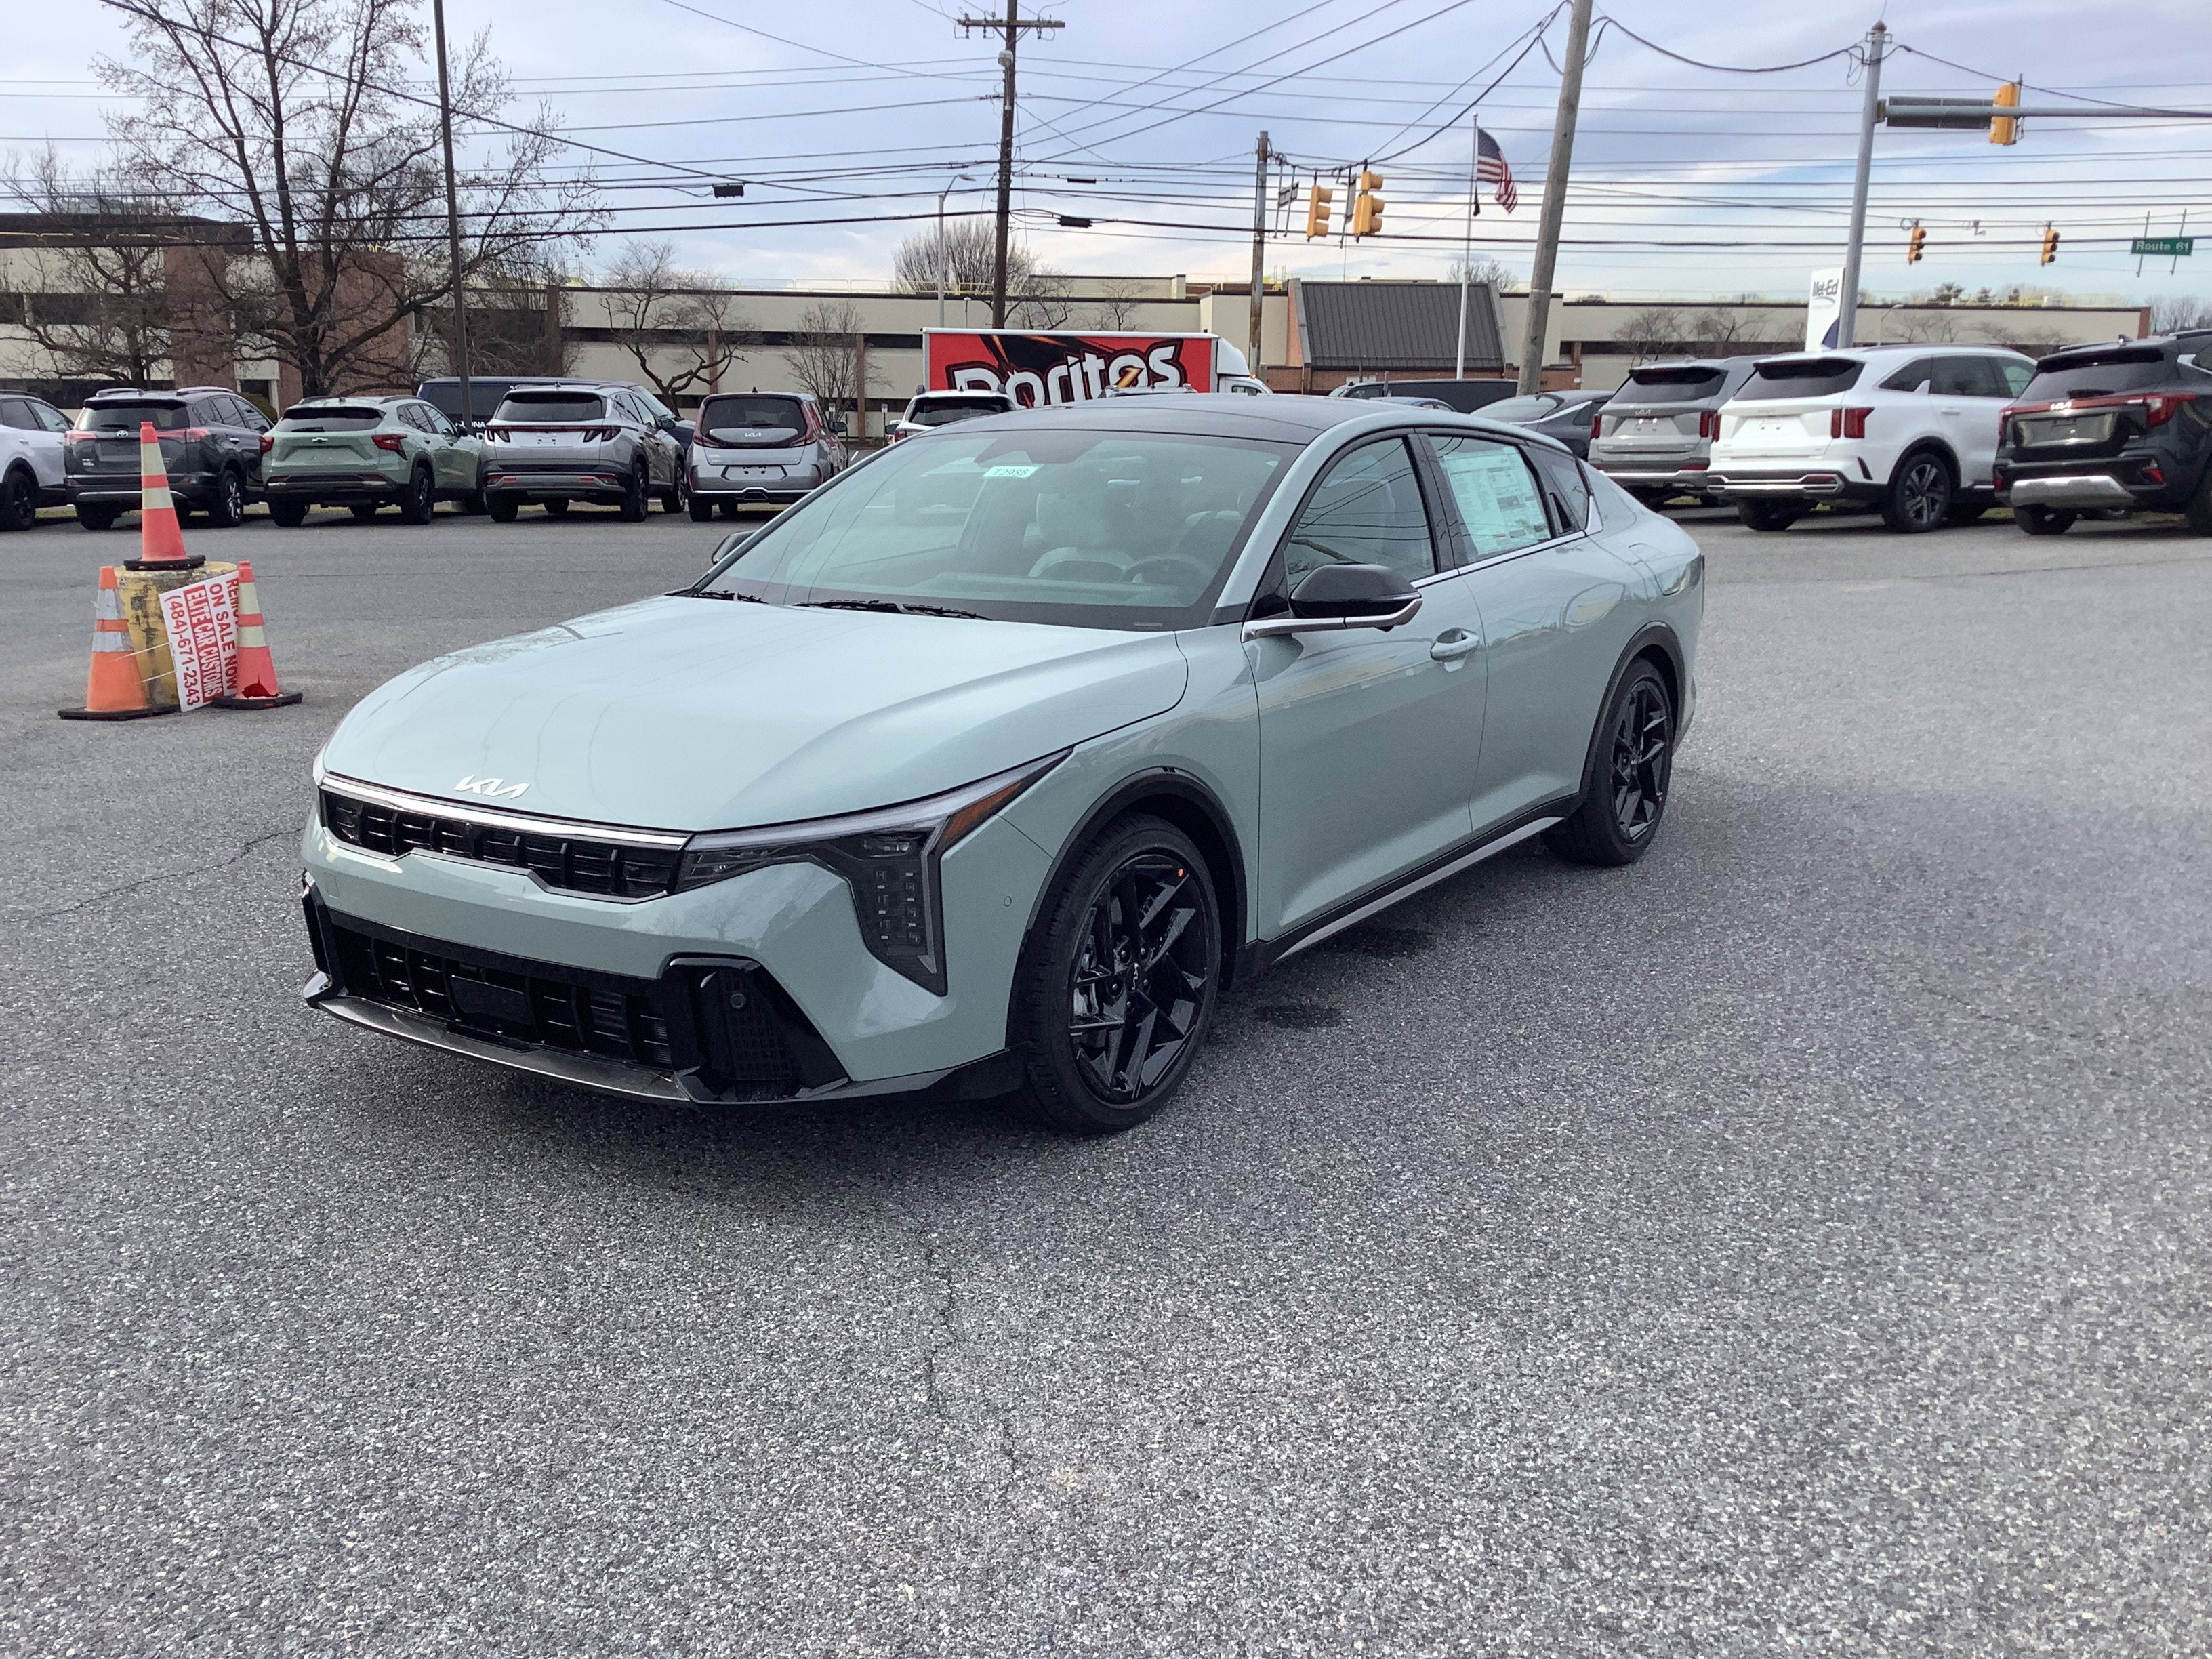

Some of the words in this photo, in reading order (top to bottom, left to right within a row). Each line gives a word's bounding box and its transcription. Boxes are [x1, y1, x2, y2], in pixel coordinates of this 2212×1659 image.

[2136, 240, 2171, 251] Route
[2175, 241, 2189, 252] 61
[1812, 279, 1839, 297] Met-Ed
[186, 589, 212, 624] ELITE
[210, 583, 226, 608] ON
[194, 623, 217, 649] CAR
[216, 611, 236, 652] SALE
[164, 595, 200, 706] (484)-671-2343
[199, 646, 224, 697] CUSTOMS
[224, 654, 238, 690] NOW
[453, 775, 531, 800] KIA
